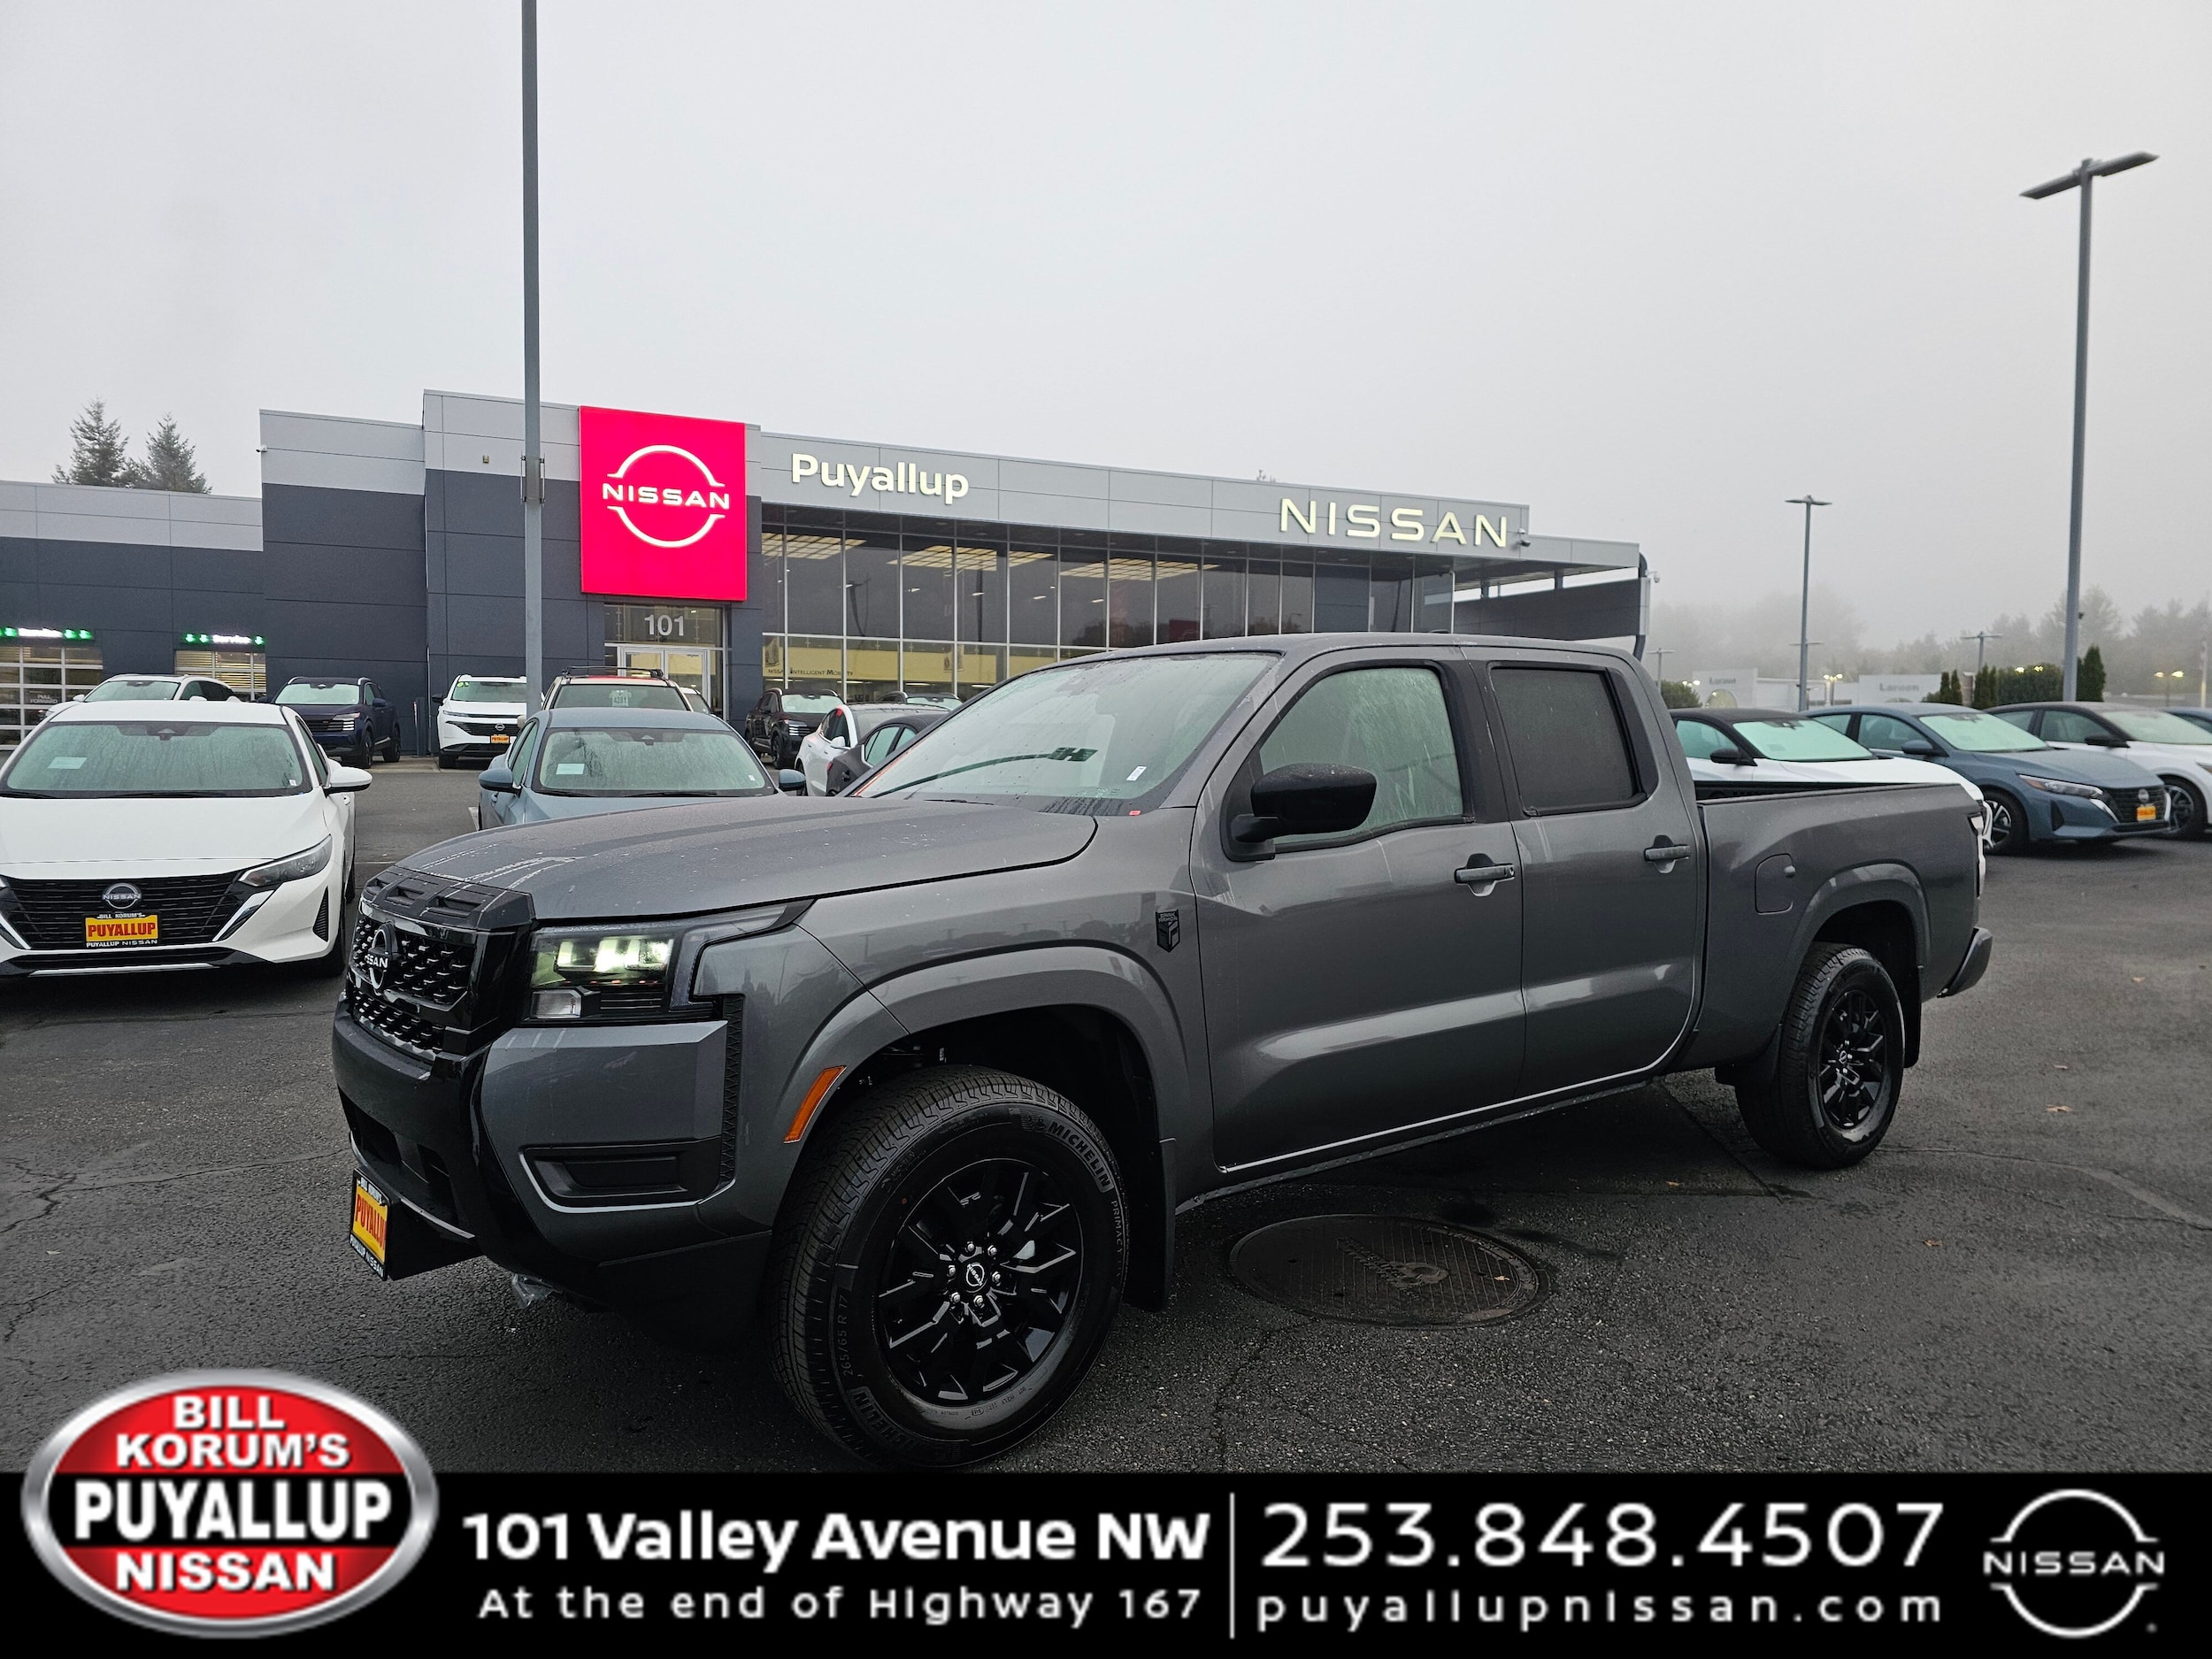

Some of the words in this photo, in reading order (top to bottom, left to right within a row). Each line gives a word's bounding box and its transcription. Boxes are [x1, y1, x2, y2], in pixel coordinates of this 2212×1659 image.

[602, 482, 730, 510] NISSAN
[791, 453, 970, 504] Puyallup
[1280, 498, 1508, 548] NISSAN
[644, 614, 684, 636] 101
[88, 922, 156, 937] PUYALLUP
[1048, 1121, 1110, 1187] MICHELIN
[1110, 1200, 1123, 1254] PRIMACY
[837, 1314, 848, 1325] R
[838, 1294, 849, 1310] 17
[836, 1329, 854, 1377] 265/65
